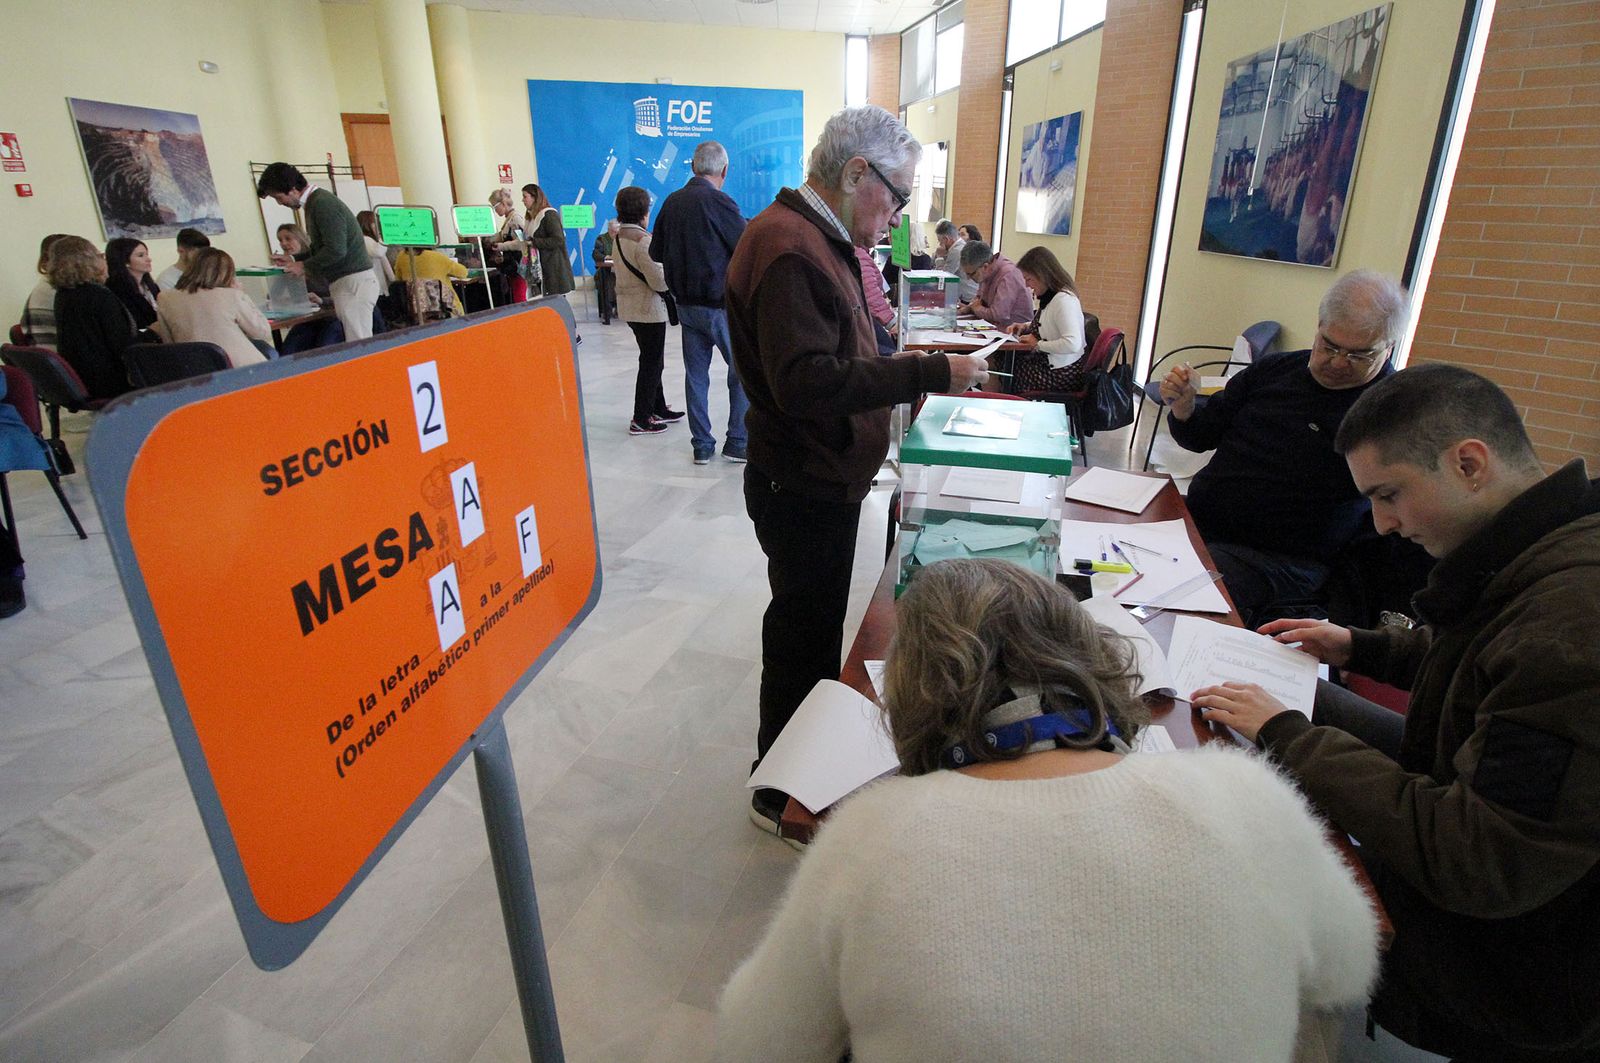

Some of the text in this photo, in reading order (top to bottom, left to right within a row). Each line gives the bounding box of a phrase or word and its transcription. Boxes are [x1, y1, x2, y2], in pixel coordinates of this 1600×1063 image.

[666, 99, 713, 124] FOE
[260, 382, 441, 496] SECCIÓN 2
[290, 476, 480, 637] MESA A
[326, 517, 532, 744] De la letra A a la F
[335, 559, 555, 778] (Orden alfabético primer apellido)
